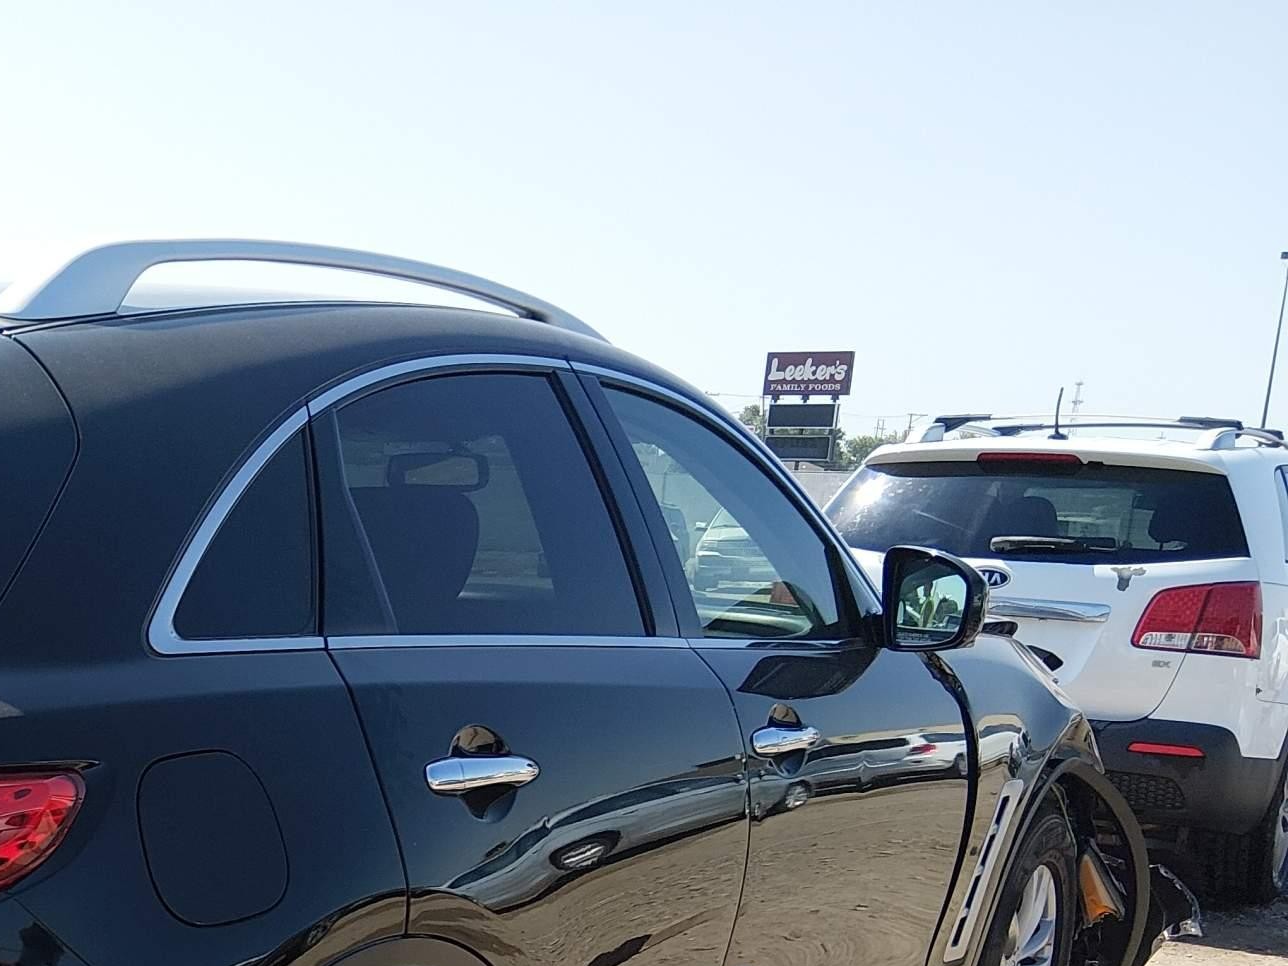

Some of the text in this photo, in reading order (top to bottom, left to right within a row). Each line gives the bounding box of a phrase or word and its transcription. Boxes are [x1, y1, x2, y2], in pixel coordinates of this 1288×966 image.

[768, 358, 848, 381] Leeker's
[770, 383, 841, 391] FAMILY FOODS
